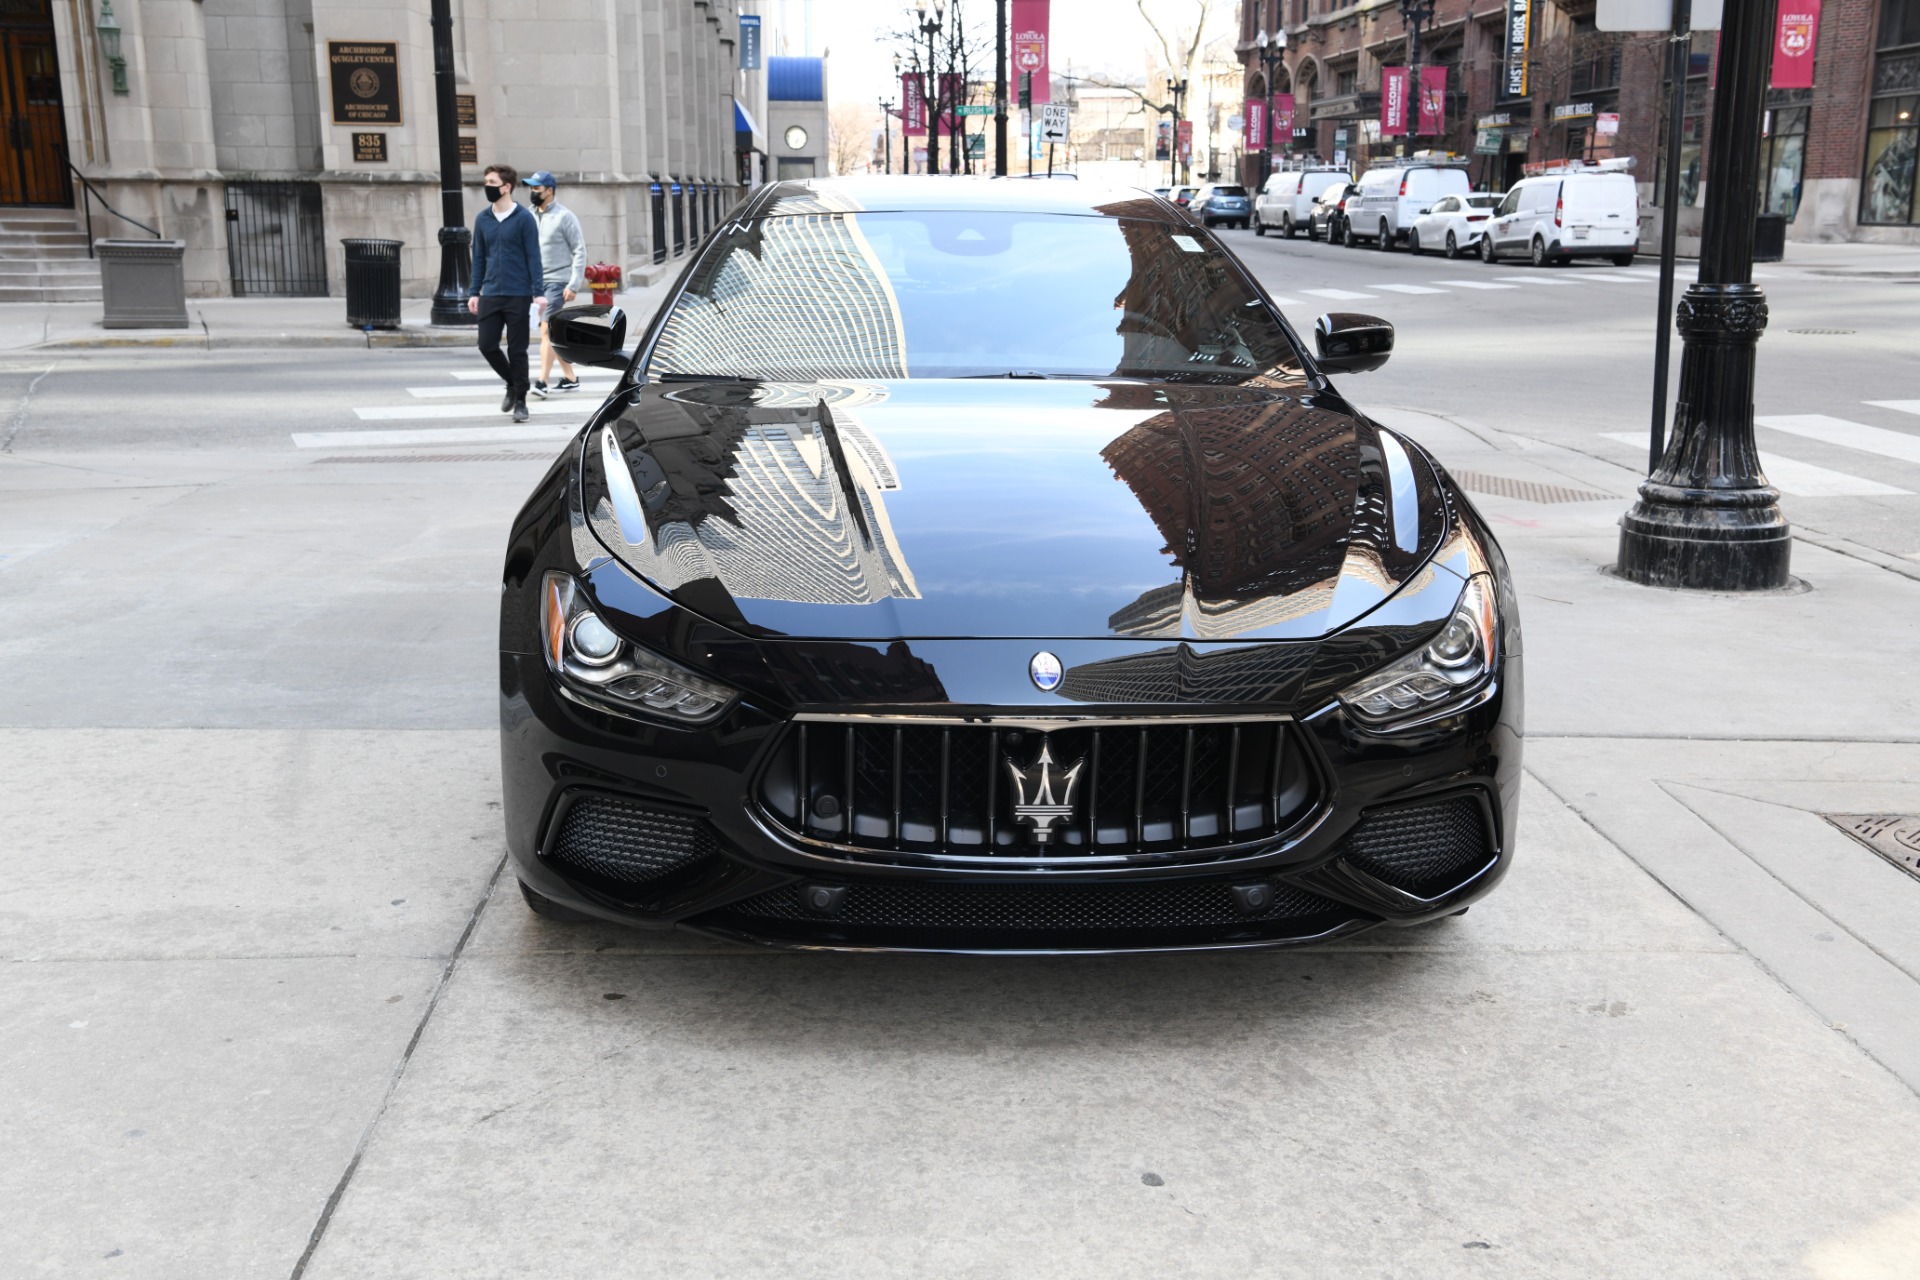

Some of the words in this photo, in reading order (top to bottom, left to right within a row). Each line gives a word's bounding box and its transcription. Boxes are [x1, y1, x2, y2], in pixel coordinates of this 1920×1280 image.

[339, 46, 387, 54] ARCHBISHOP
[331, 55, 364, 64] QUIGLEY
[1387, 75, 1398, 128] WELCOME
[963, 106, 984, 115] RUSH
[1045, 107, 1066, 118] ONE
[1044, 119, 1066, 128] WAY
[1250, 105, 1258, 145] WELCOME
[358, 135, 380, 147] 835
